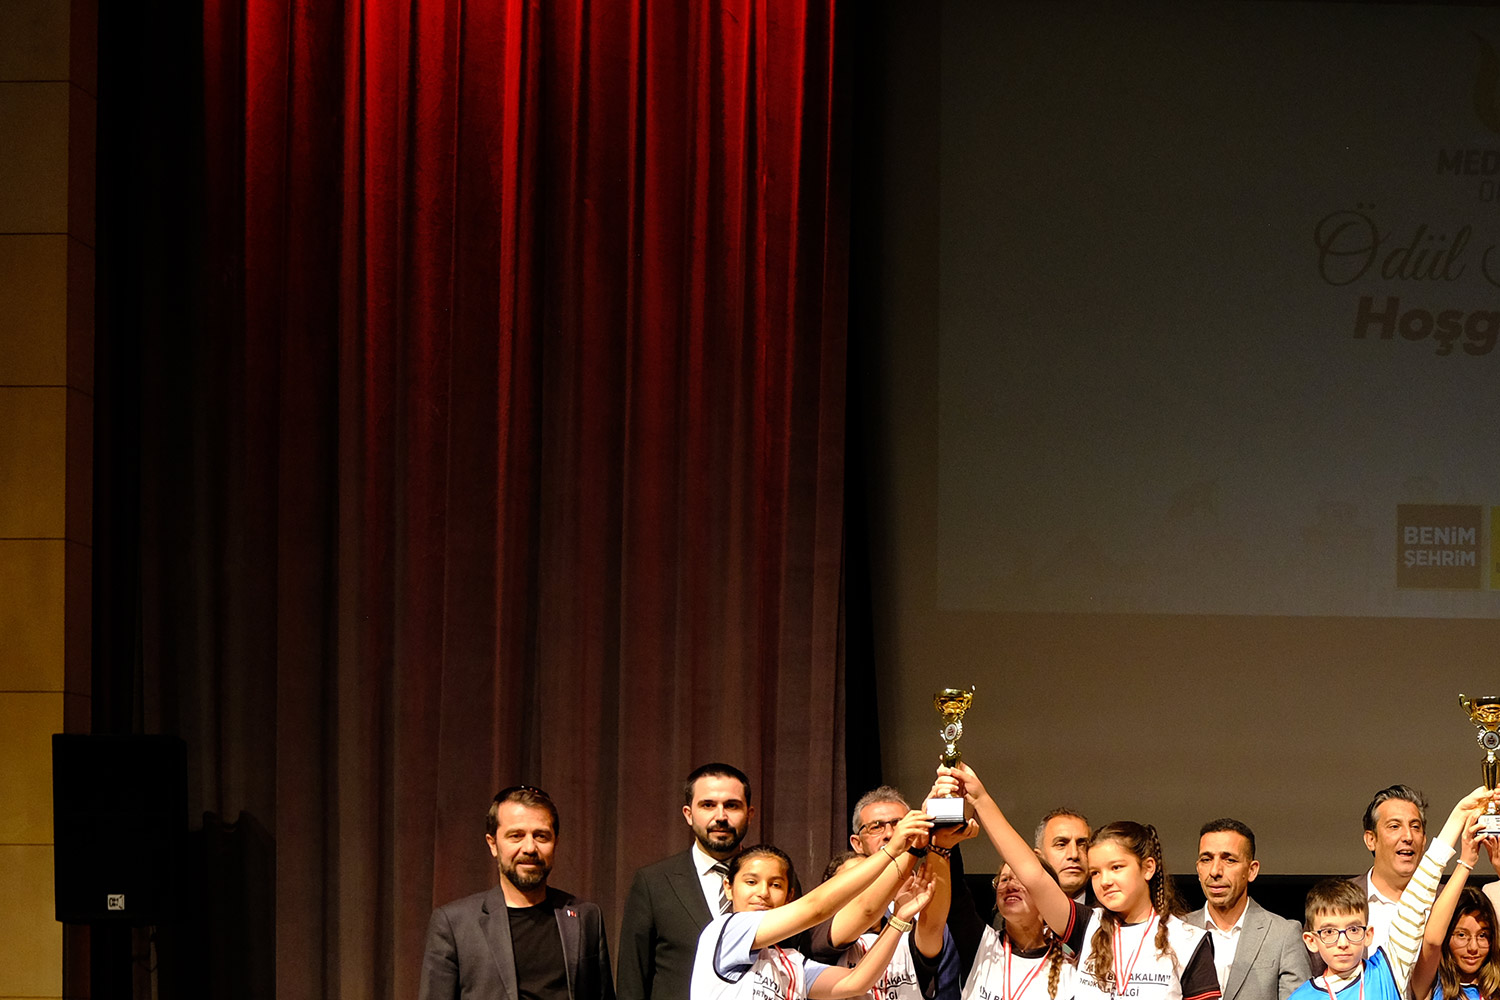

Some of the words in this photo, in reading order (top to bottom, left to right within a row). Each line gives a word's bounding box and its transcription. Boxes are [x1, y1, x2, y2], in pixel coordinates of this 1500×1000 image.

[1314, 201, 1473, 287] Ödül
[1403, 526, 1476, 545] BENİM
[1403, 549, 1476, 569] ŞEHRİM
[1130, 973, 1171, 983] AKALIM"
